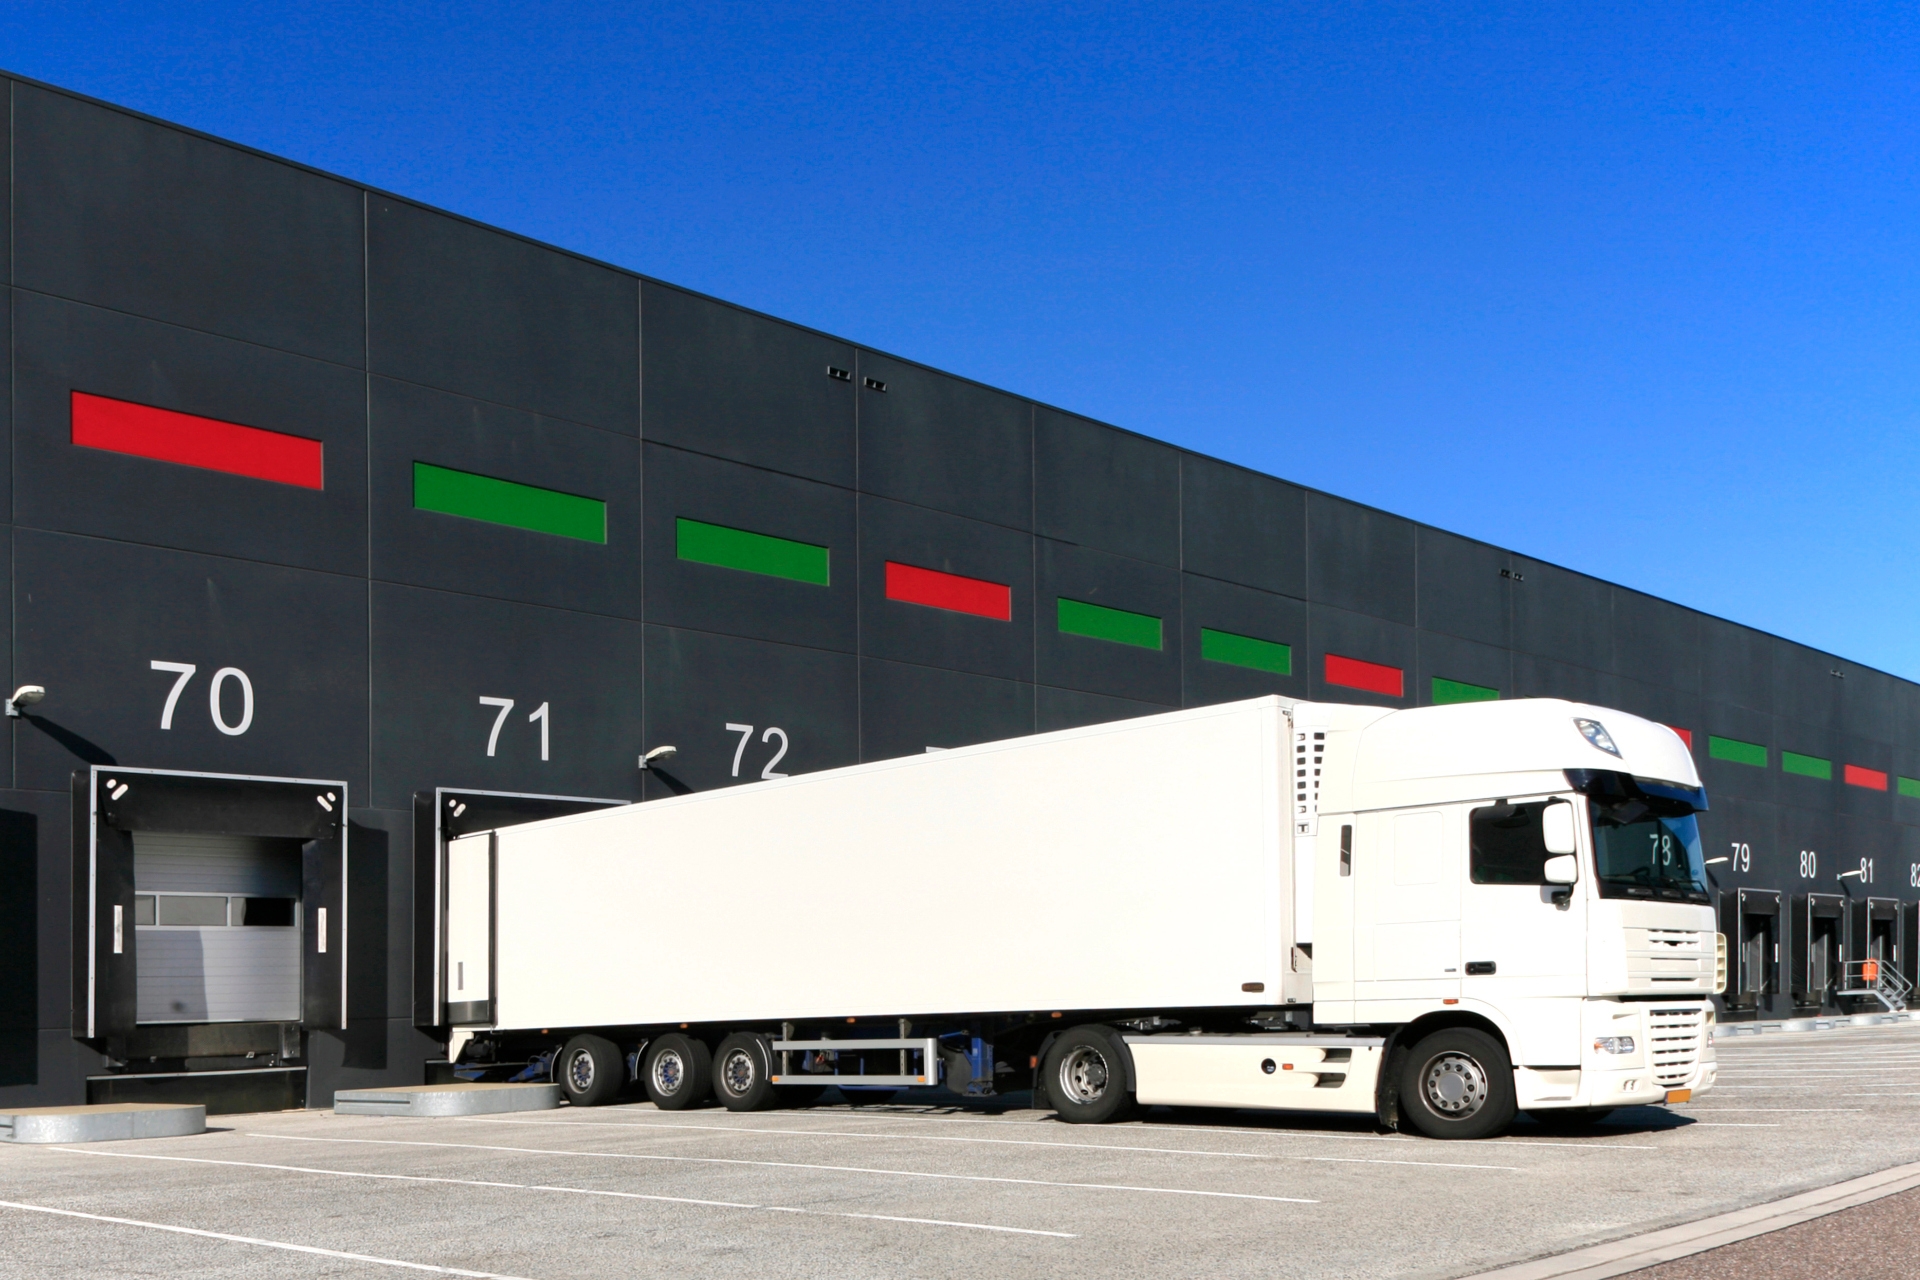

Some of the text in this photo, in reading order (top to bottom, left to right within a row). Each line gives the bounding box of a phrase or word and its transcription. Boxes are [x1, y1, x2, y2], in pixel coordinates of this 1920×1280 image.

[150, 659, 255, 737] 70
[479, 695, 550, 762] 71
[725, 722, 789, 780] 72
[1649, 833, 1671, 866] 78
[1731, 842, 1750, 872] 79
[1800, 850, 1816, 878] 80
[1859, 857, 1874, 884] 81
